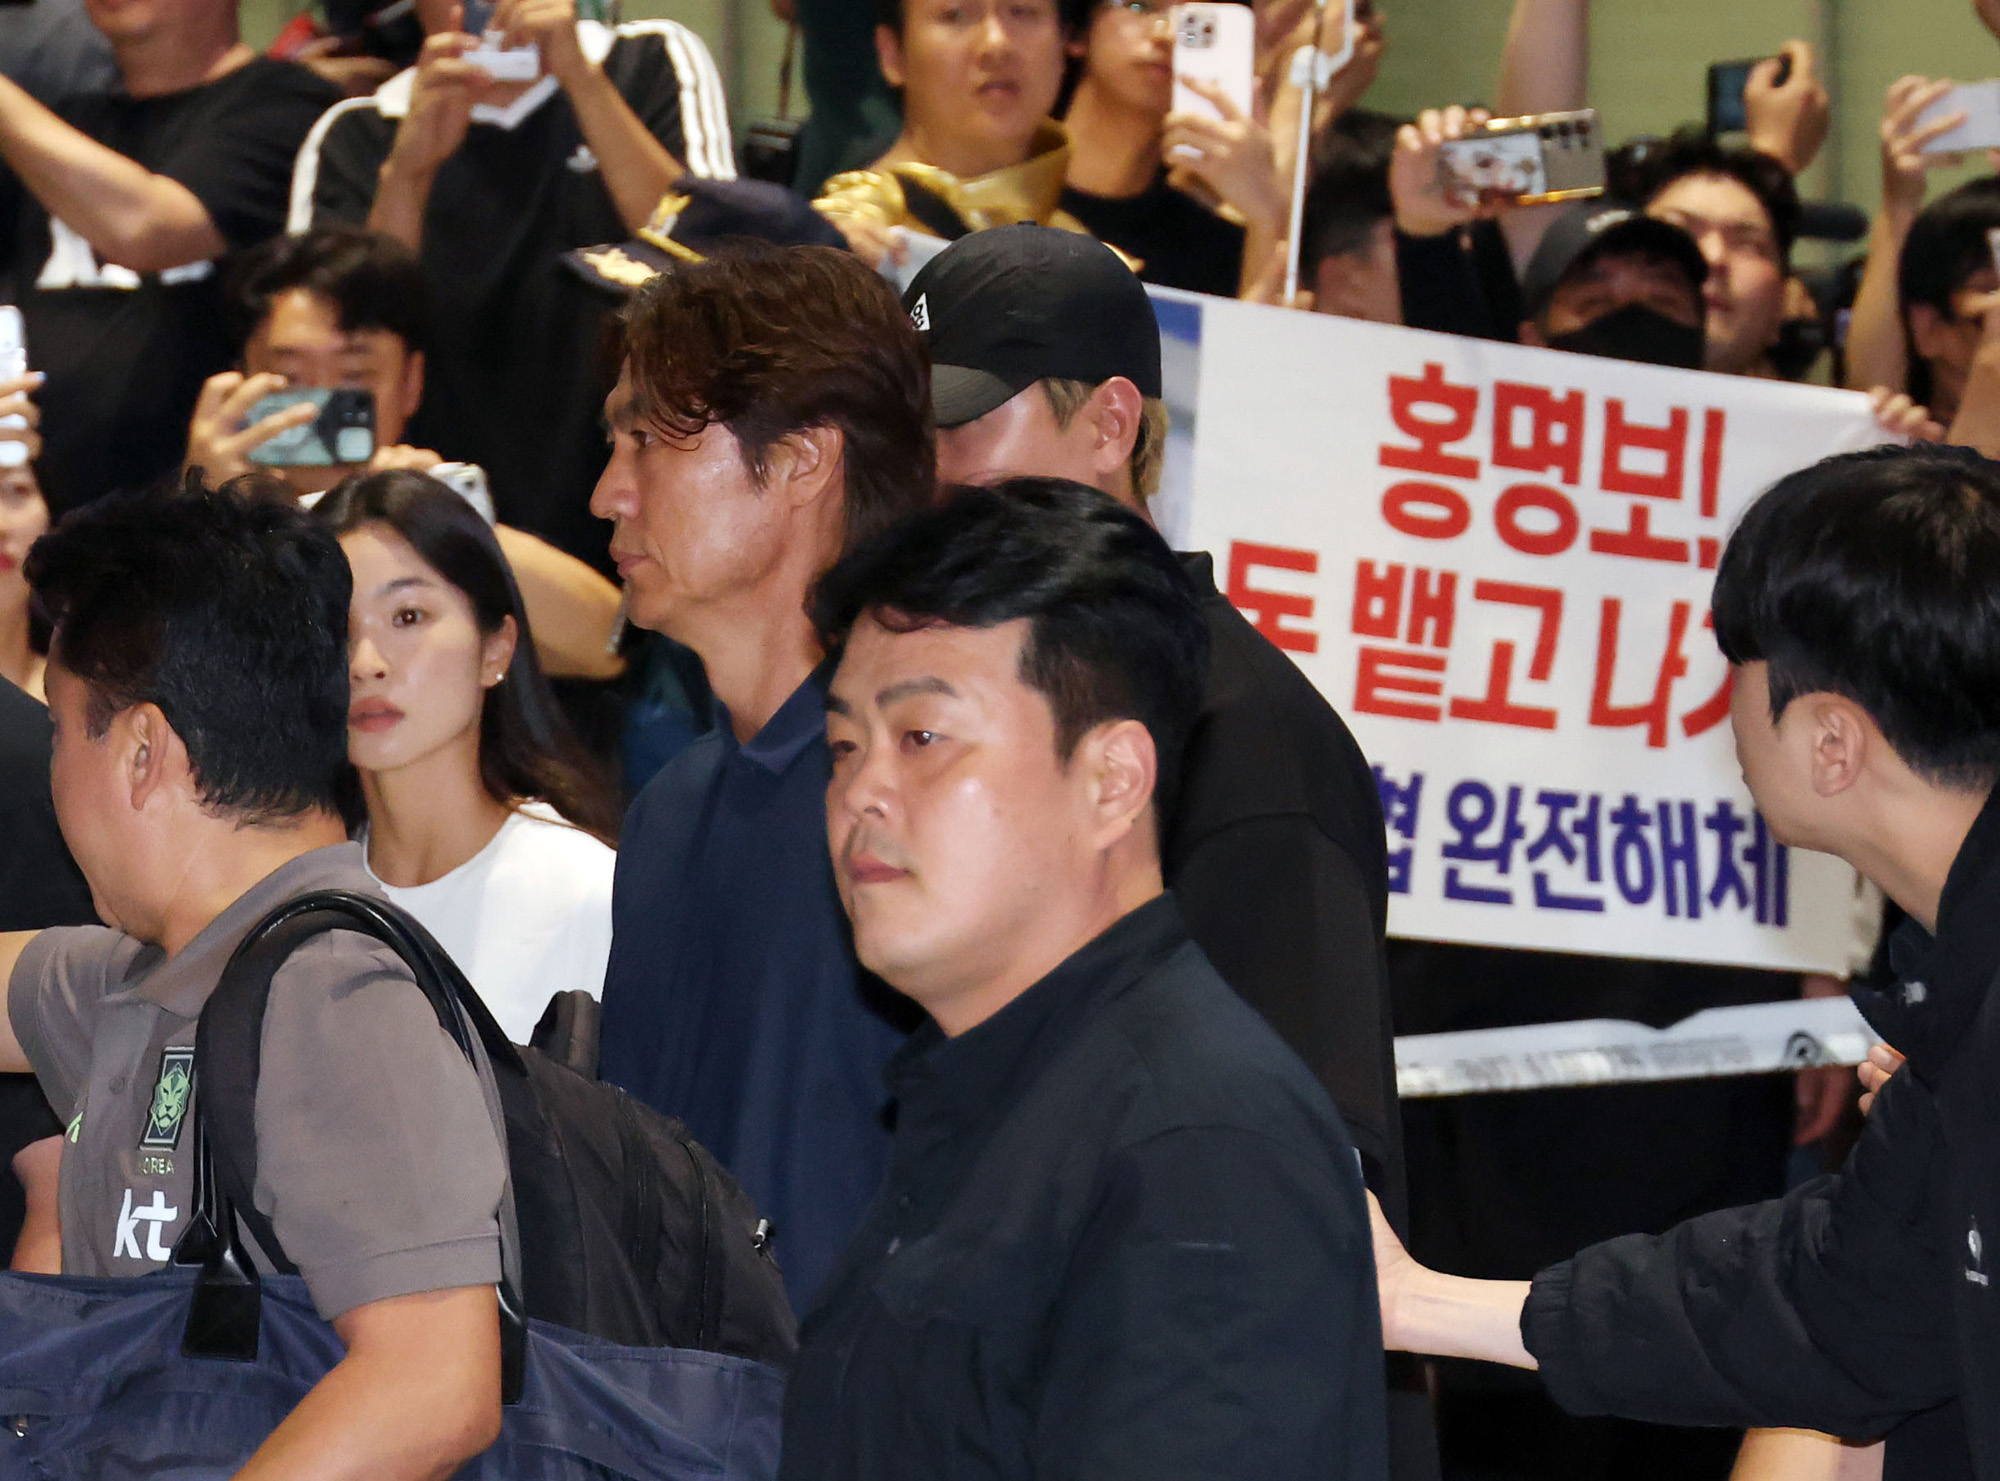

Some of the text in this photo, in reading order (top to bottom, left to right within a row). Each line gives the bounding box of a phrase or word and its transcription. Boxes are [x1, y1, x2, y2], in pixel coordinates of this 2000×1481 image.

[1378, 362, 1726, 571] 홍명보!
[1350, 558, 1565, 732] 뱉고
[1442, 779, 1789, 928] 완전해체
[112, 1187, 179, 1262] kt
